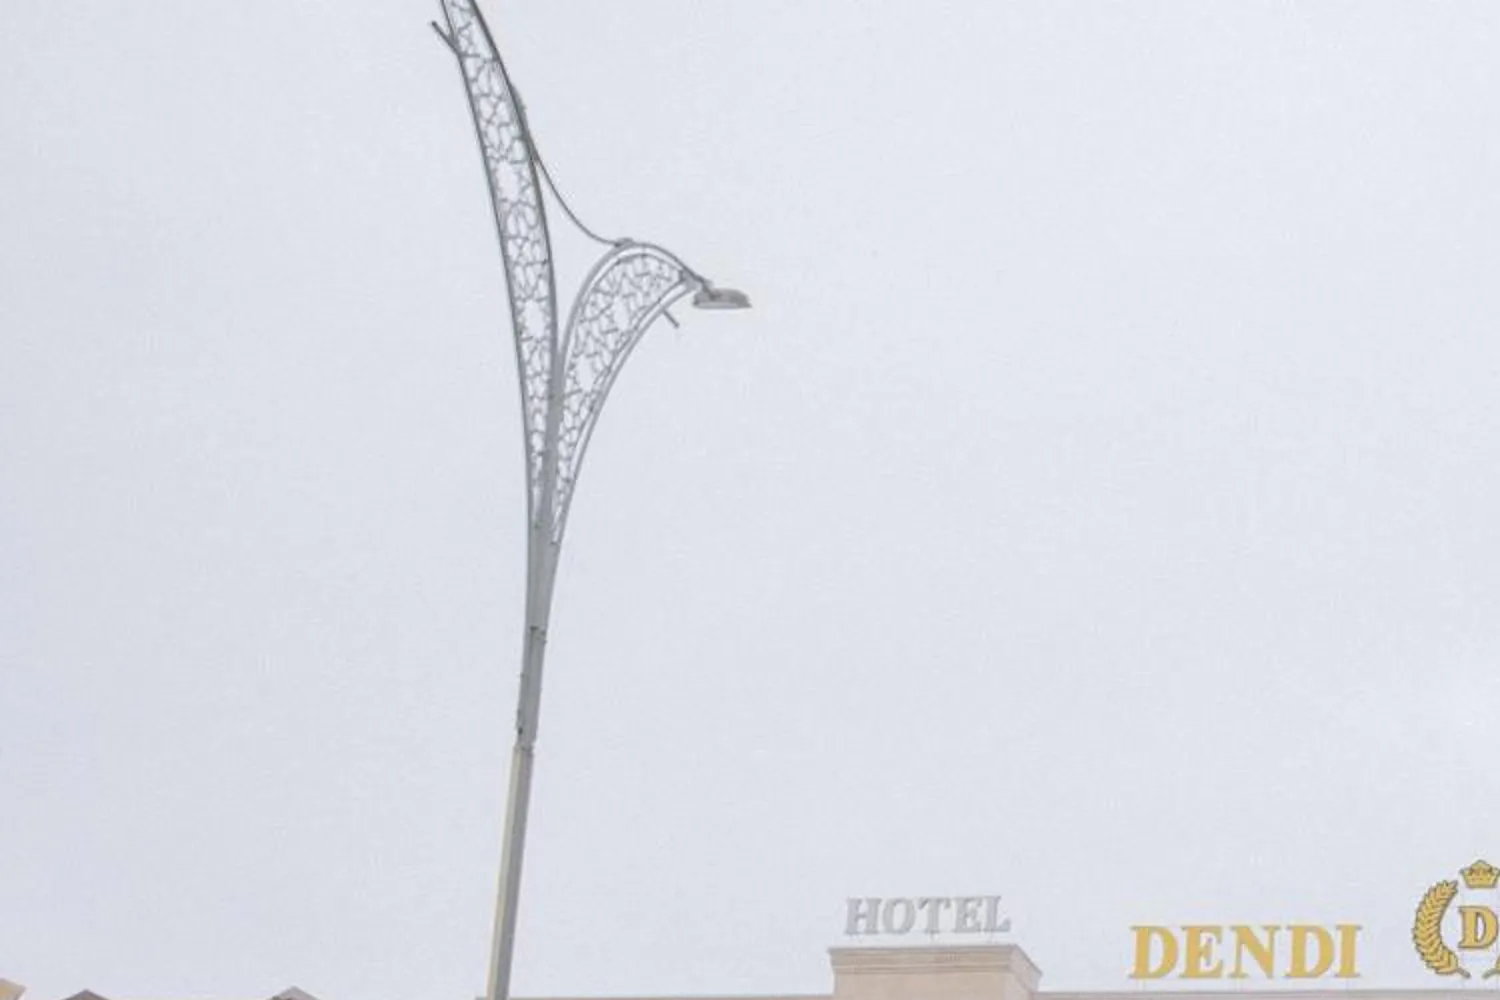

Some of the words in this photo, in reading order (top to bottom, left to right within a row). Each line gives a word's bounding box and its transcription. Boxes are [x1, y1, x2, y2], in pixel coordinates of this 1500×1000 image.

[843, 895, 1010, 935] HOTEL
[1458, 905, 1498, 949] D
[1128, 925, 1362, 978] DENDI
